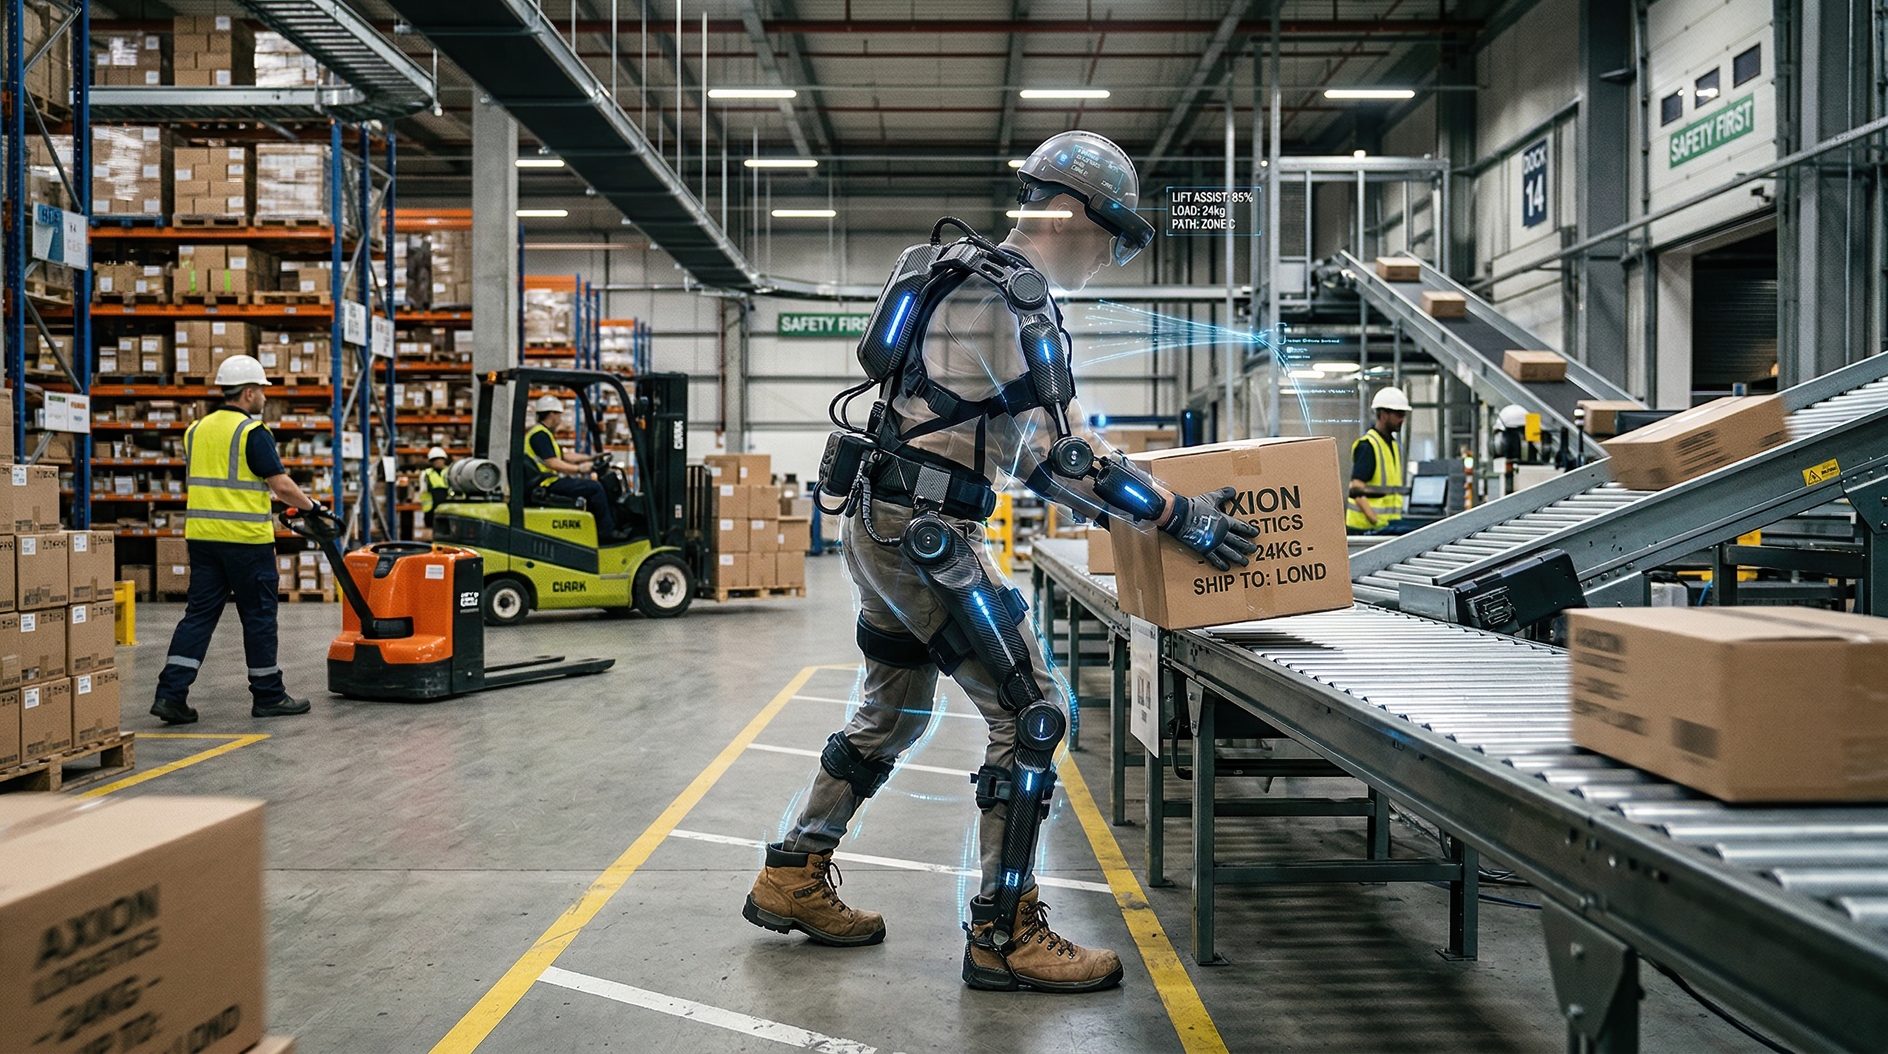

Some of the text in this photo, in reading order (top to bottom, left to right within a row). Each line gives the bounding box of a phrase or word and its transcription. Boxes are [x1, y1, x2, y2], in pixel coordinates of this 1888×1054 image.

[1671, 100, 1752, 162] SAFETY FIRST
[1523, 145, 1547, 175] DOCK
[1525, 173, 1545, 217] 14
[781, 316, 870, 332] SAFETY FIRS
[1228, 485, 1301, 517] XION
[552, 519, 582, 530] CLARK
[1248, 514, 1304, 534] STICS
[1255, 540, 1302, 562] 24KG
[552, 581, 587, 593] CLARK
[1193, 562, 1327, 595] SHIP TO: LOND
[33, 882, 160, 973] AXION
[31, 926, 161, 1006] LOGISTICS
[56, 974, 141, 1044] 24KG
